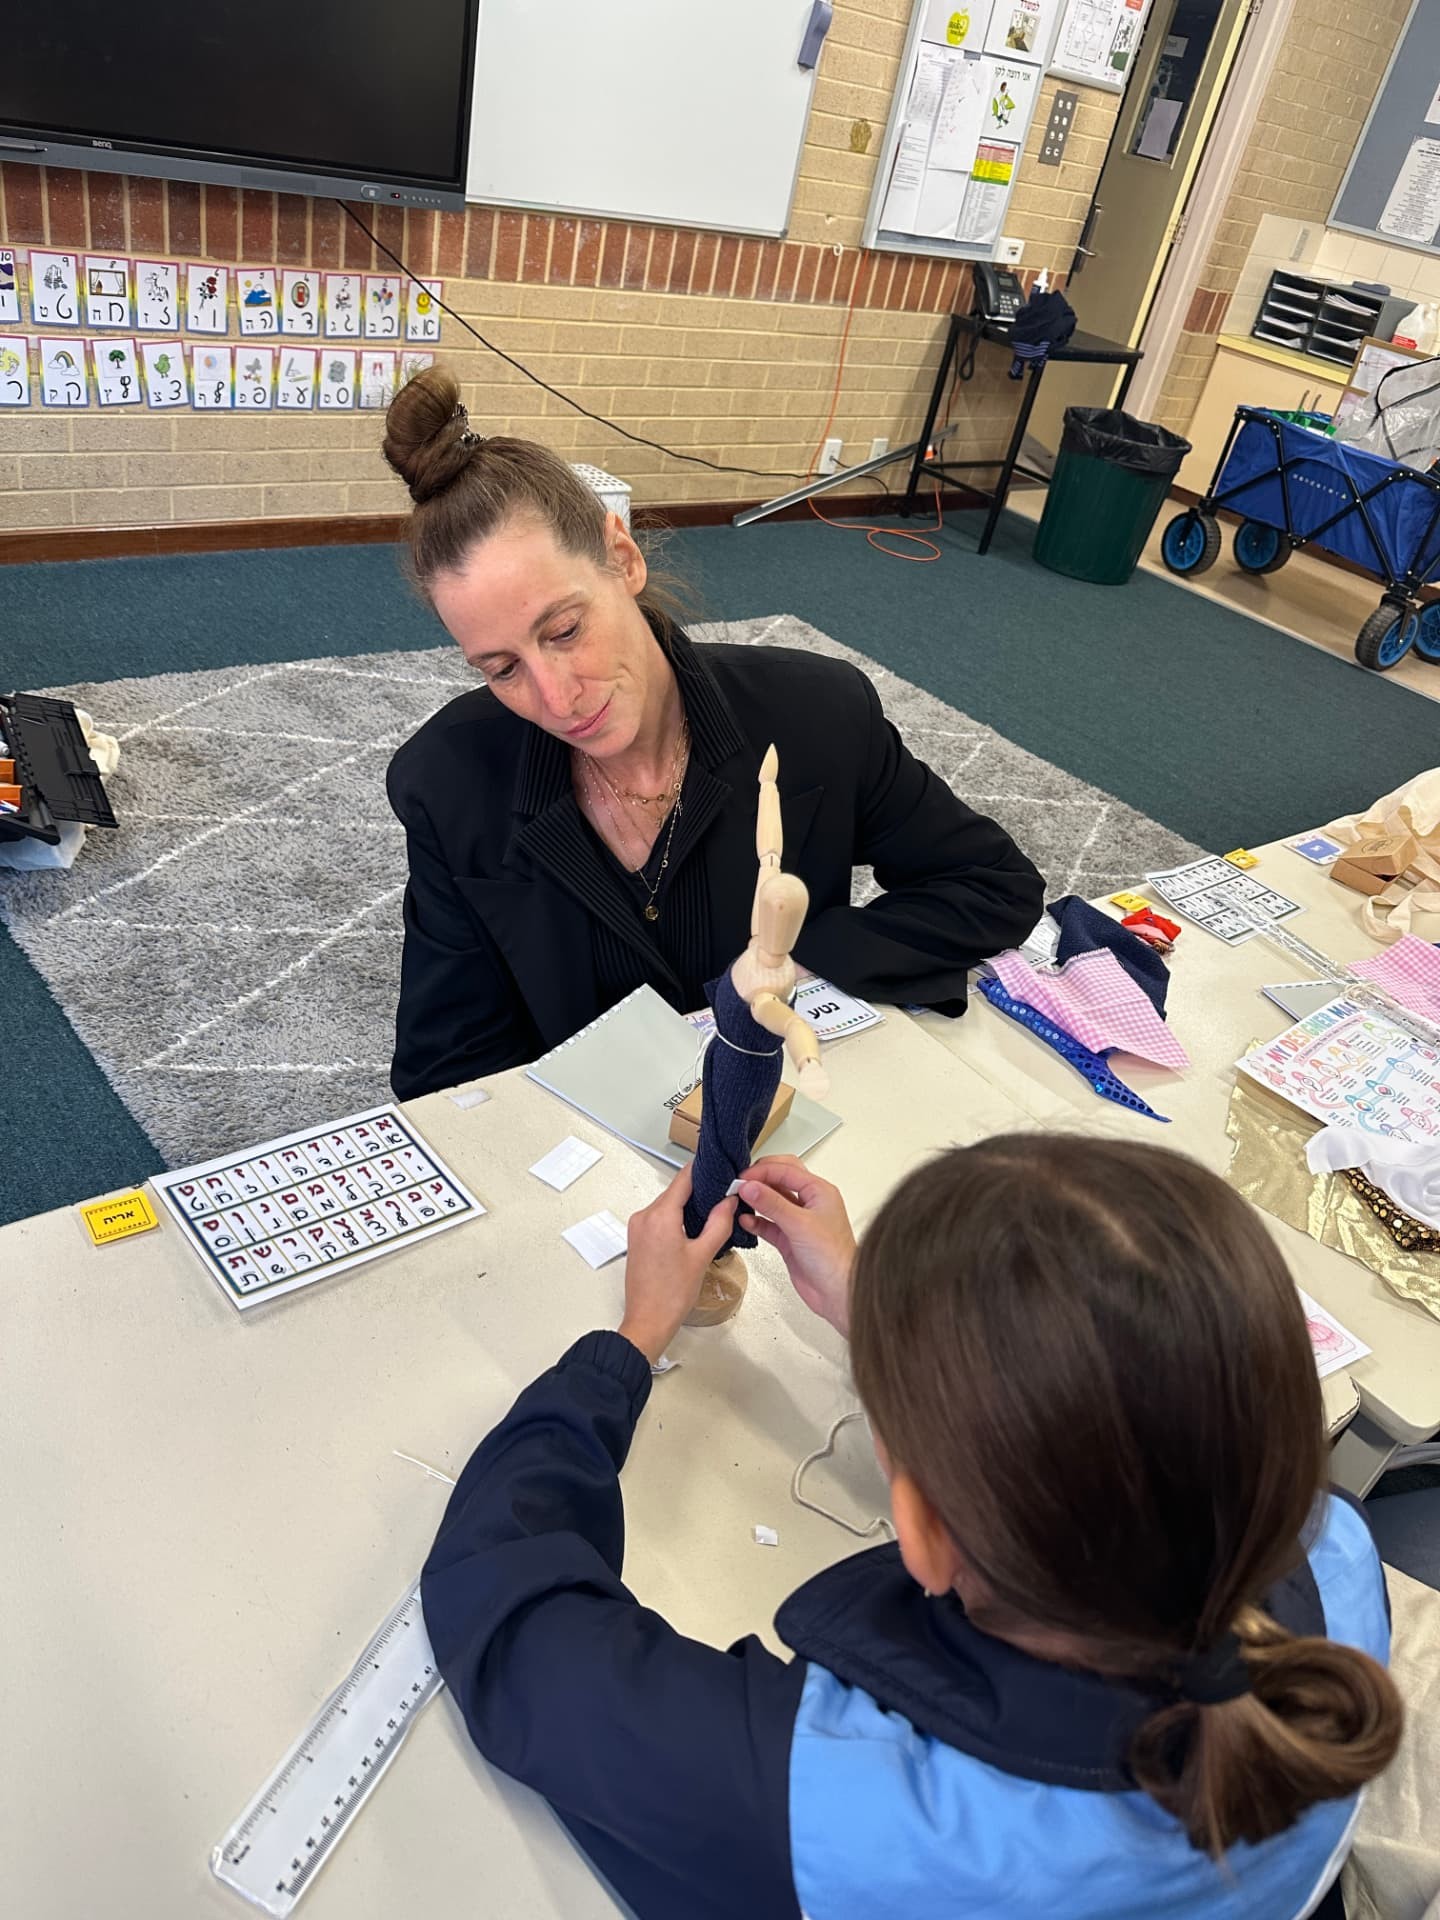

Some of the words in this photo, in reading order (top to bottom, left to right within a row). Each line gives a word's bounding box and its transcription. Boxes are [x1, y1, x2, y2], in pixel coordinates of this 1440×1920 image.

[807, 1002, 840, 1020] נטע
[1280, 1011, 1339, 1053] DESIGNER
[375, 1119, 392, 1131] א
[355, 1127, 370, 1138] ב
[332, 1135, 344, 1146] ג
[307, 1142, 320, 1152] ד
[282, 1150, 298, 1162] ה
[404, 1151, 412, 1159] י
[259, 1160, 269, 1170] ו
[381, 1159, 394, 1170] כ
[234, 1168, 245, 1178] ז
[357, 1166, 372, 1179] ך
[206, 1177, 223, 1189] ח
[332, 1173, 346, 1187] ל
[178, 1185, 194, 1196] ט
[307, 1184, 325, 1196] מ
[430, 1182, 443, 1195] ע
[282, 1193, 299, 1205] ם
[408, 1191, 422, 1203] פ
[260, 1203, 270, 1214] נ
[385, 1200, 400, 1211] ף
[232, 1211, 245, 1225] ן
[360, 1208, 374, 1221] צ
[203, 1219, 219, 1231] ס
[333, 1218, 351, 1230] ץ
[308, 1227, 324, 1242] ק
[282, 1238, 297, 1247] ר
[253, 1245, 272, 1258] ש
[228, 1255, 247, 1269] ת
